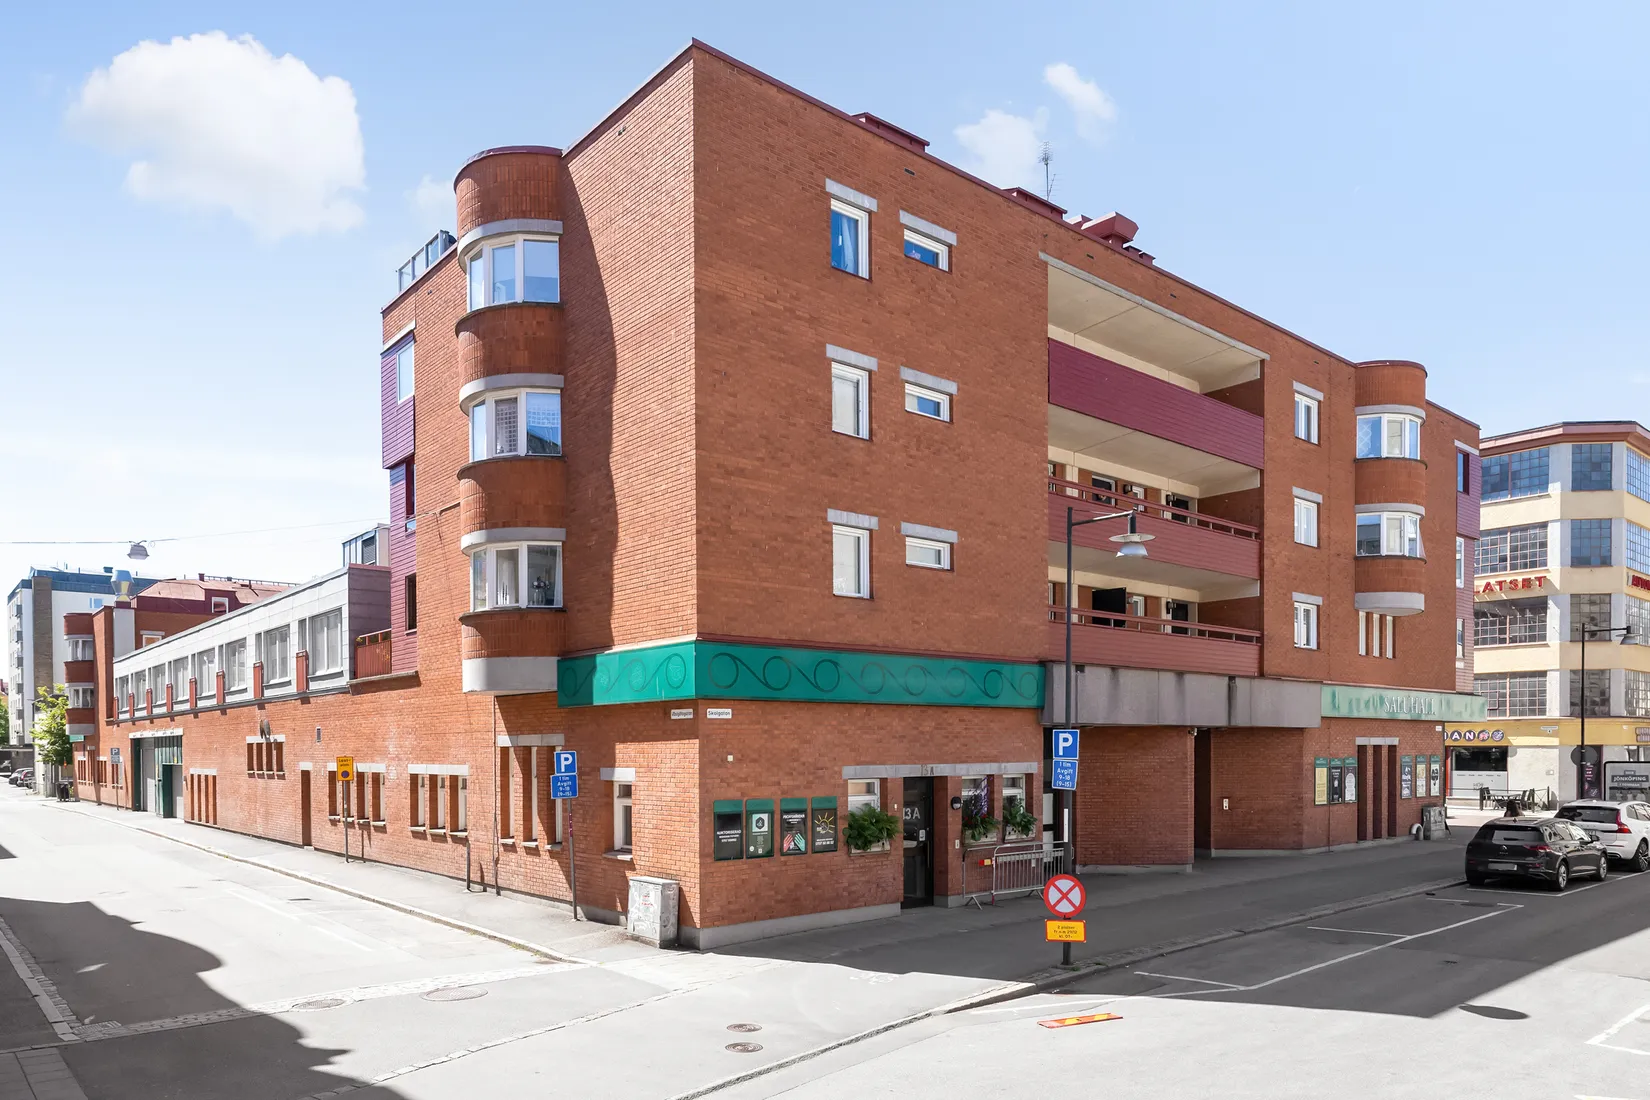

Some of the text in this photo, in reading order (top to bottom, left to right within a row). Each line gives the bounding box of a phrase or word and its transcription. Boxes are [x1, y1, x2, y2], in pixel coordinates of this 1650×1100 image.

[1383, 696, 1436, 715] SALUHALL
[1059, 733, 1073, 755] P
[1444, 732, 1475, 740] AN
[560, 753, 573, 772] P
[912, 807, 921, 820] A
